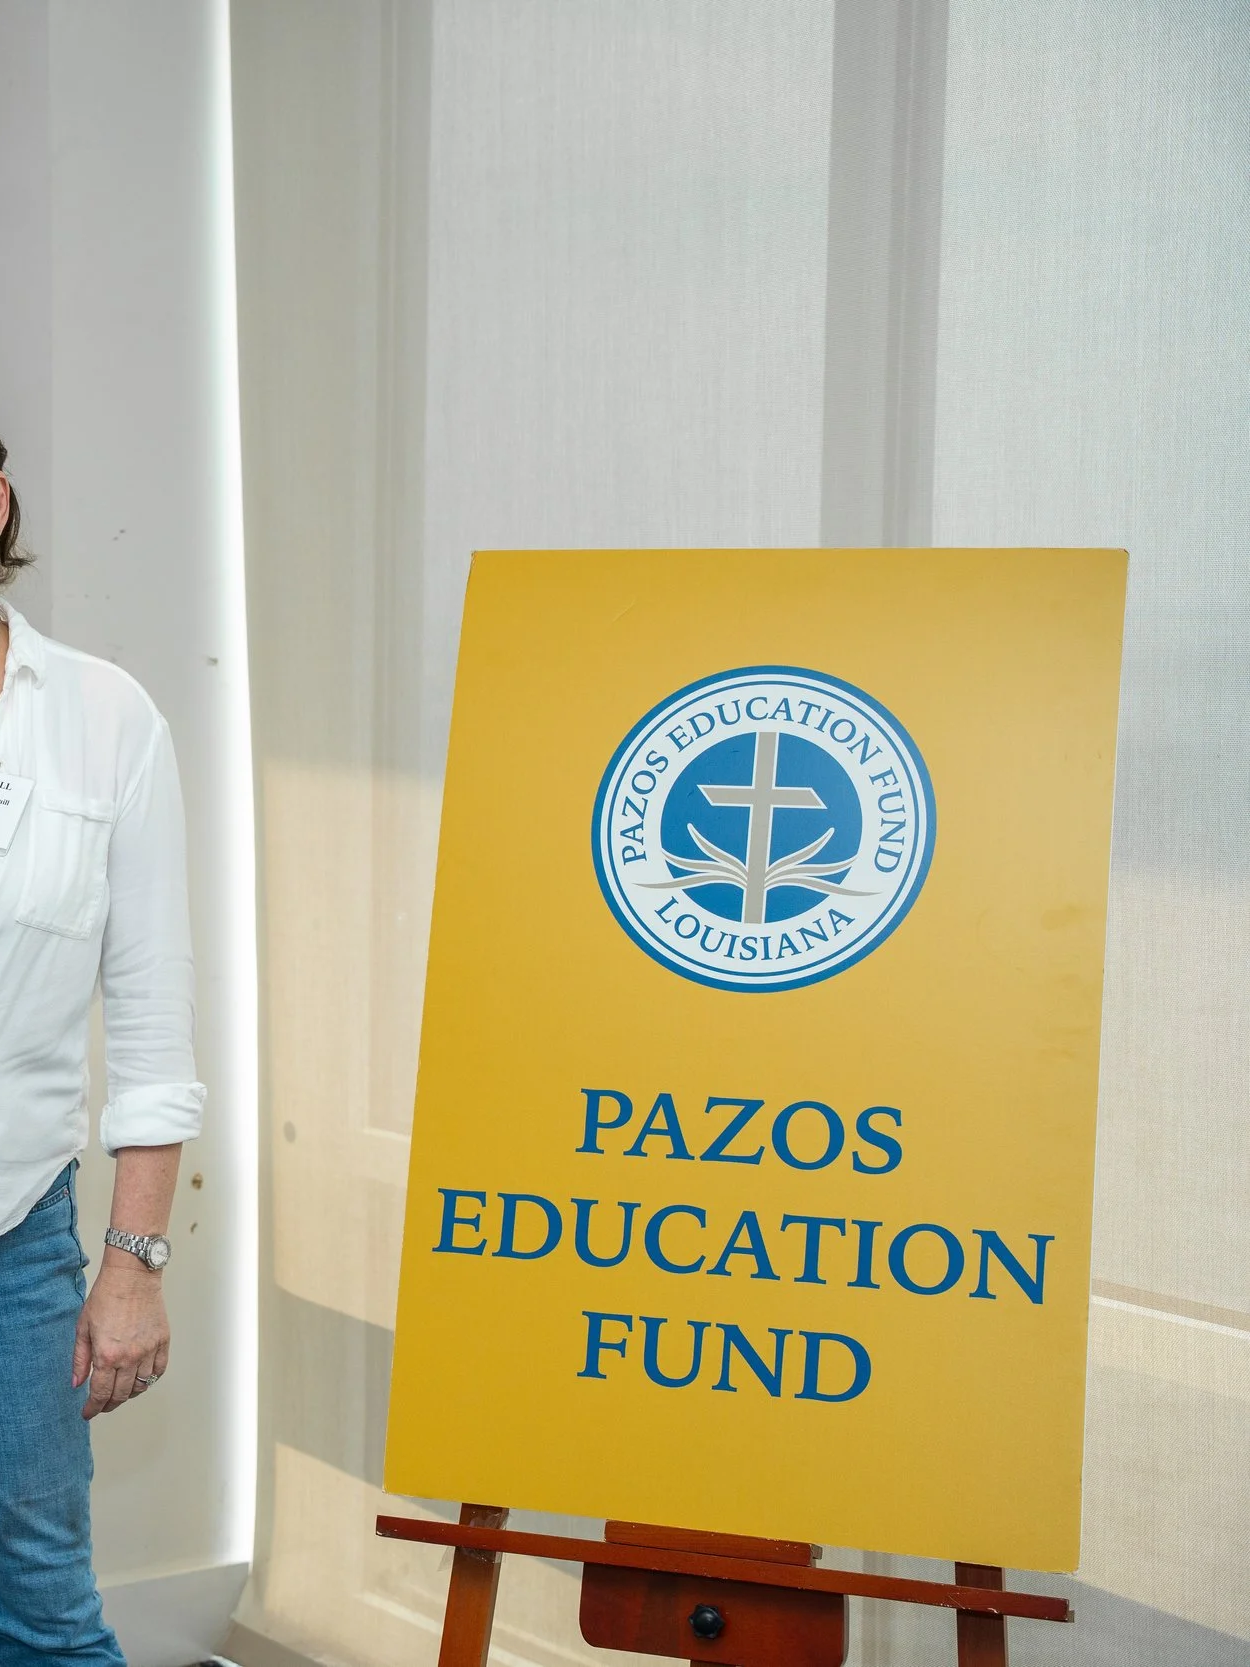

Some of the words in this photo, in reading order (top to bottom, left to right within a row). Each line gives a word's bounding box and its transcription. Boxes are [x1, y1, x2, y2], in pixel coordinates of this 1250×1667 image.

[622, 749, 669, 864] PAZOS
[669, 696, 881, 765] EDUCATION
[869, 766, 907, 875] FUND
[655, 895, 856, 961] LOUISIANA
[575, 1087, 903, 1176] PAZOS
[431, 1187, 1055, 1305] EDUCATION
[576, 1310, 872, 1403] FUND
